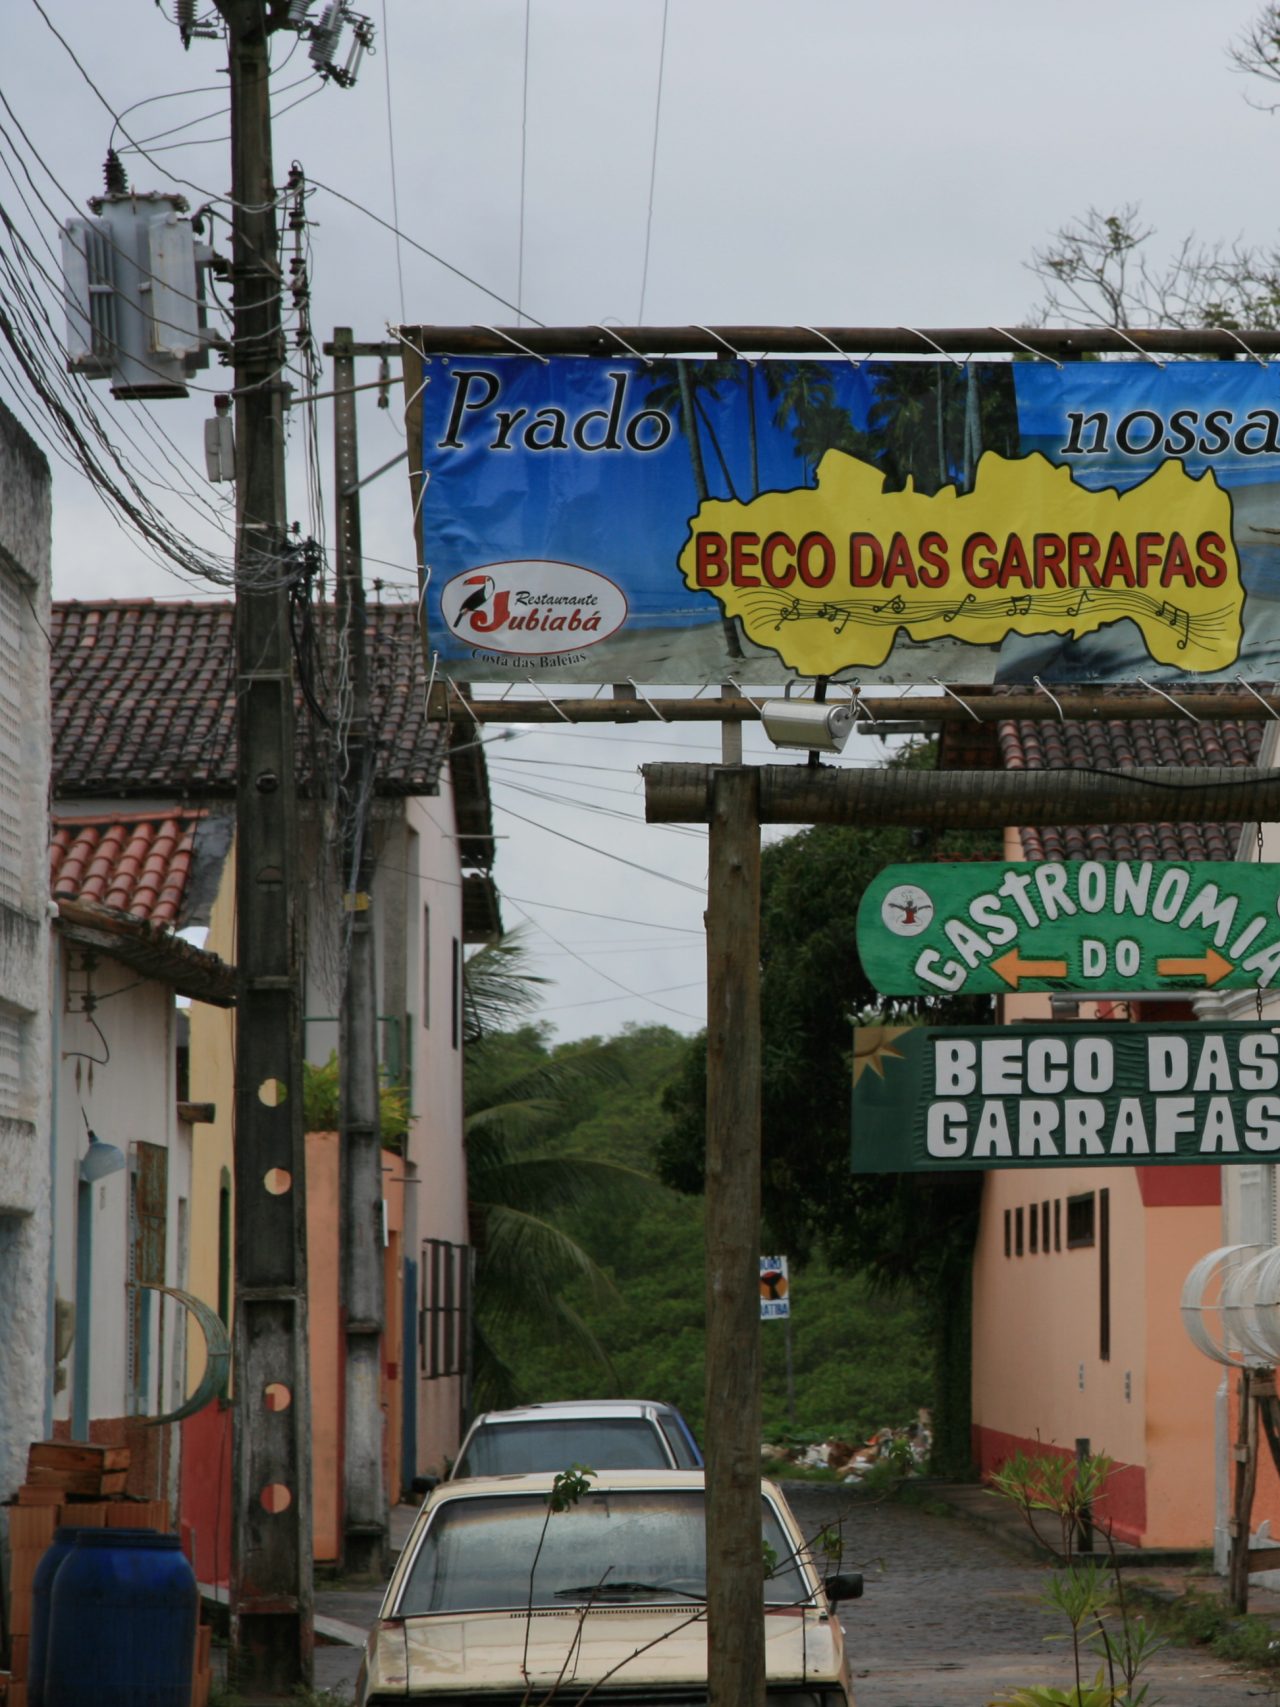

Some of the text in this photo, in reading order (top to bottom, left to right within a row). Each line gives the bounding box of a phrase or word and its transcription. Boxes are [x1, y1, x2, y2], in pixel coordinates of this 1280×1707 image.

[436, 371, 672, 451] Prado
[695, 531, 1230, 590] BECO DAS GARRAFAS
[470, 591, 602, 633] Jubiabá
[514, 591, 598, 606] Restaurante
[472, 649, 587, 668] Costa das Baleias
[1083, 939, 1140, 977] DO
[935, 1034, 1280, 1096] BECO DAS
